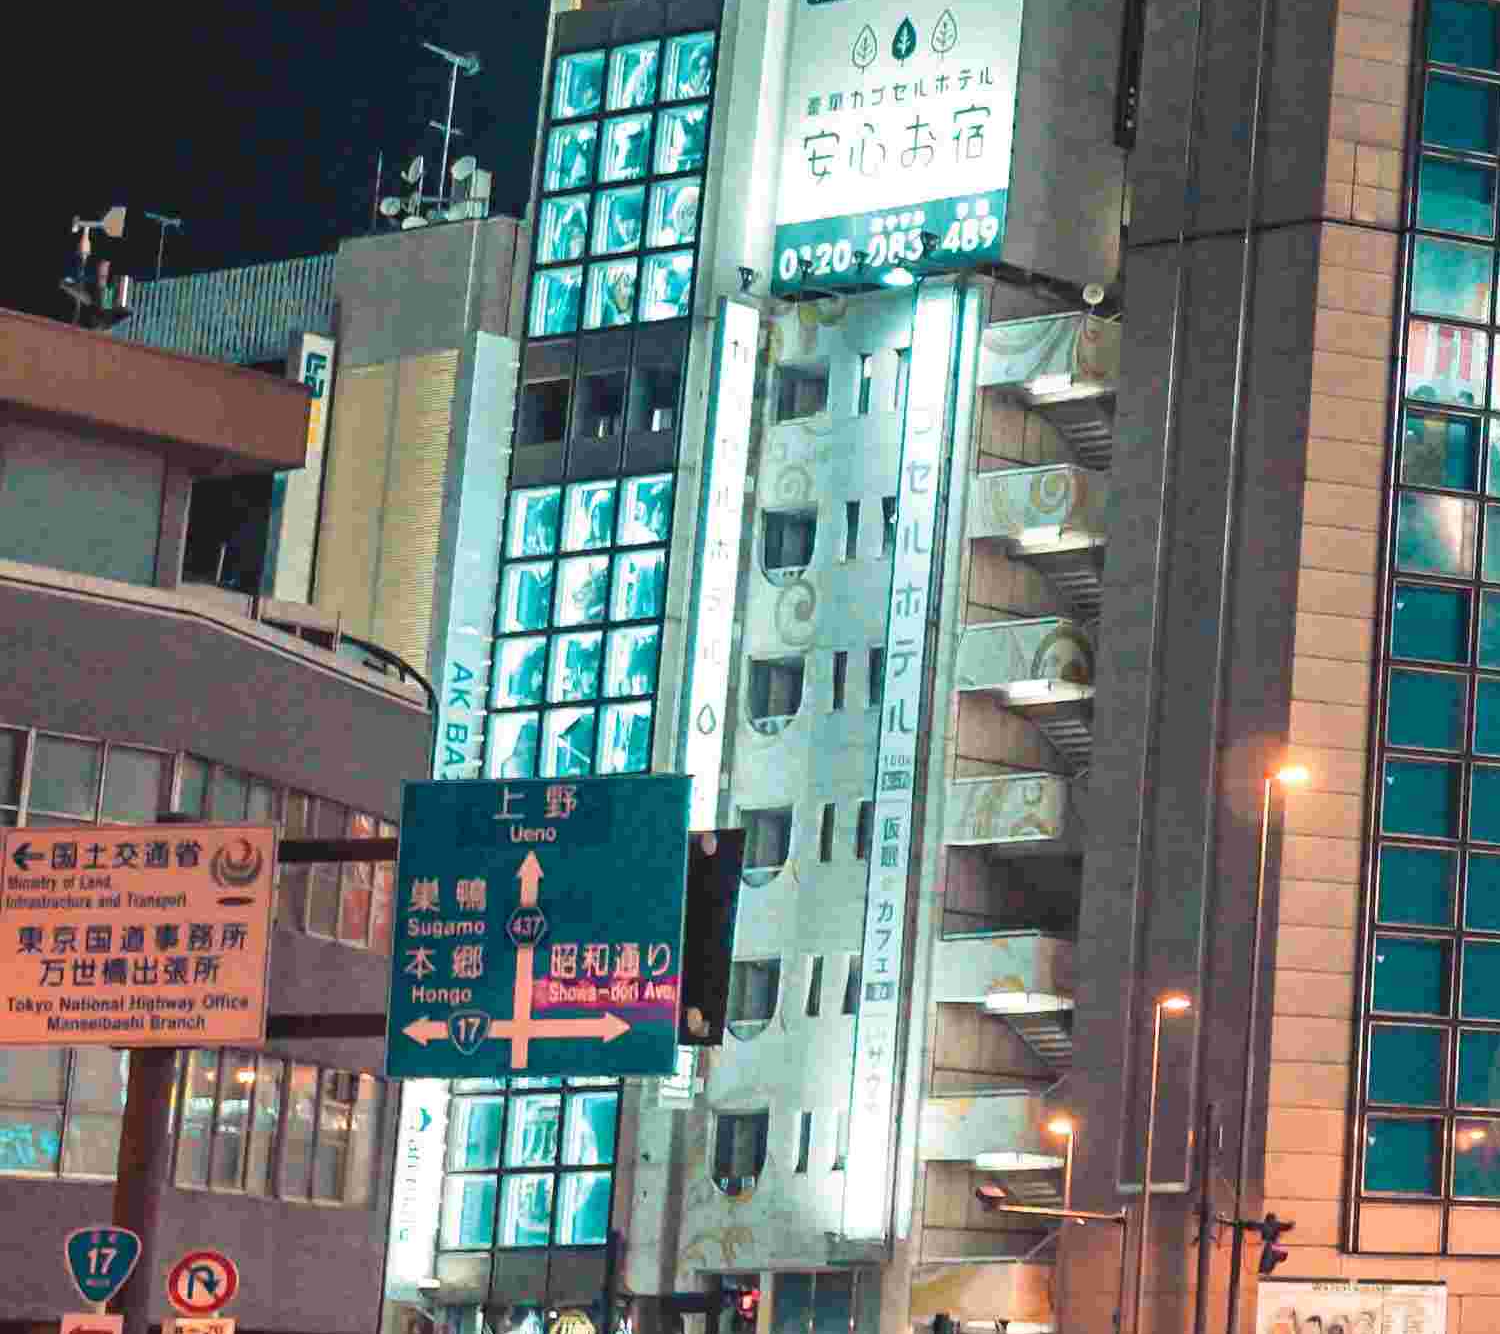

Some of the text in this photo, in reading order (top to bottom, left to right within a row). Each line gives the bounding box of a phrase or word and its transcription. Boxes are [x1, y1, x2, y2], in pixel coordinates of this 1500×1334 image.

[804, 103, 992, 185] 安心お宿
[492, 784, 579, 820] 上野
[511, 824, 557, 843] Ueno
[51, 842, 203, 870] 国土交通省
[98, 892, 121, 908] and
[127, 892, 188, 910] Transport
[408, 877, 487, 913] 巣鴨
[16, 923, 249, 954] 東京国道事務所
[407, 918, 486, 939] Sugamo
[510, 917, 545, 936] 437
[38, 957, 222, 987] 万世橋出張所
[404, 944, 484, 980] 本郷
[551, 942, 673, 981] 昭和通り
[8, 993, 249, 1015] Tokyo National Highway Office
[411, 986, 472, 1007] Hongo
[549, 981, 640, 1004] Showa-dori
[150, 1014, 207, 1031] Branch
[458, 1018, 482, 1043] 17
[87, 1247, 118, 1275] 17
